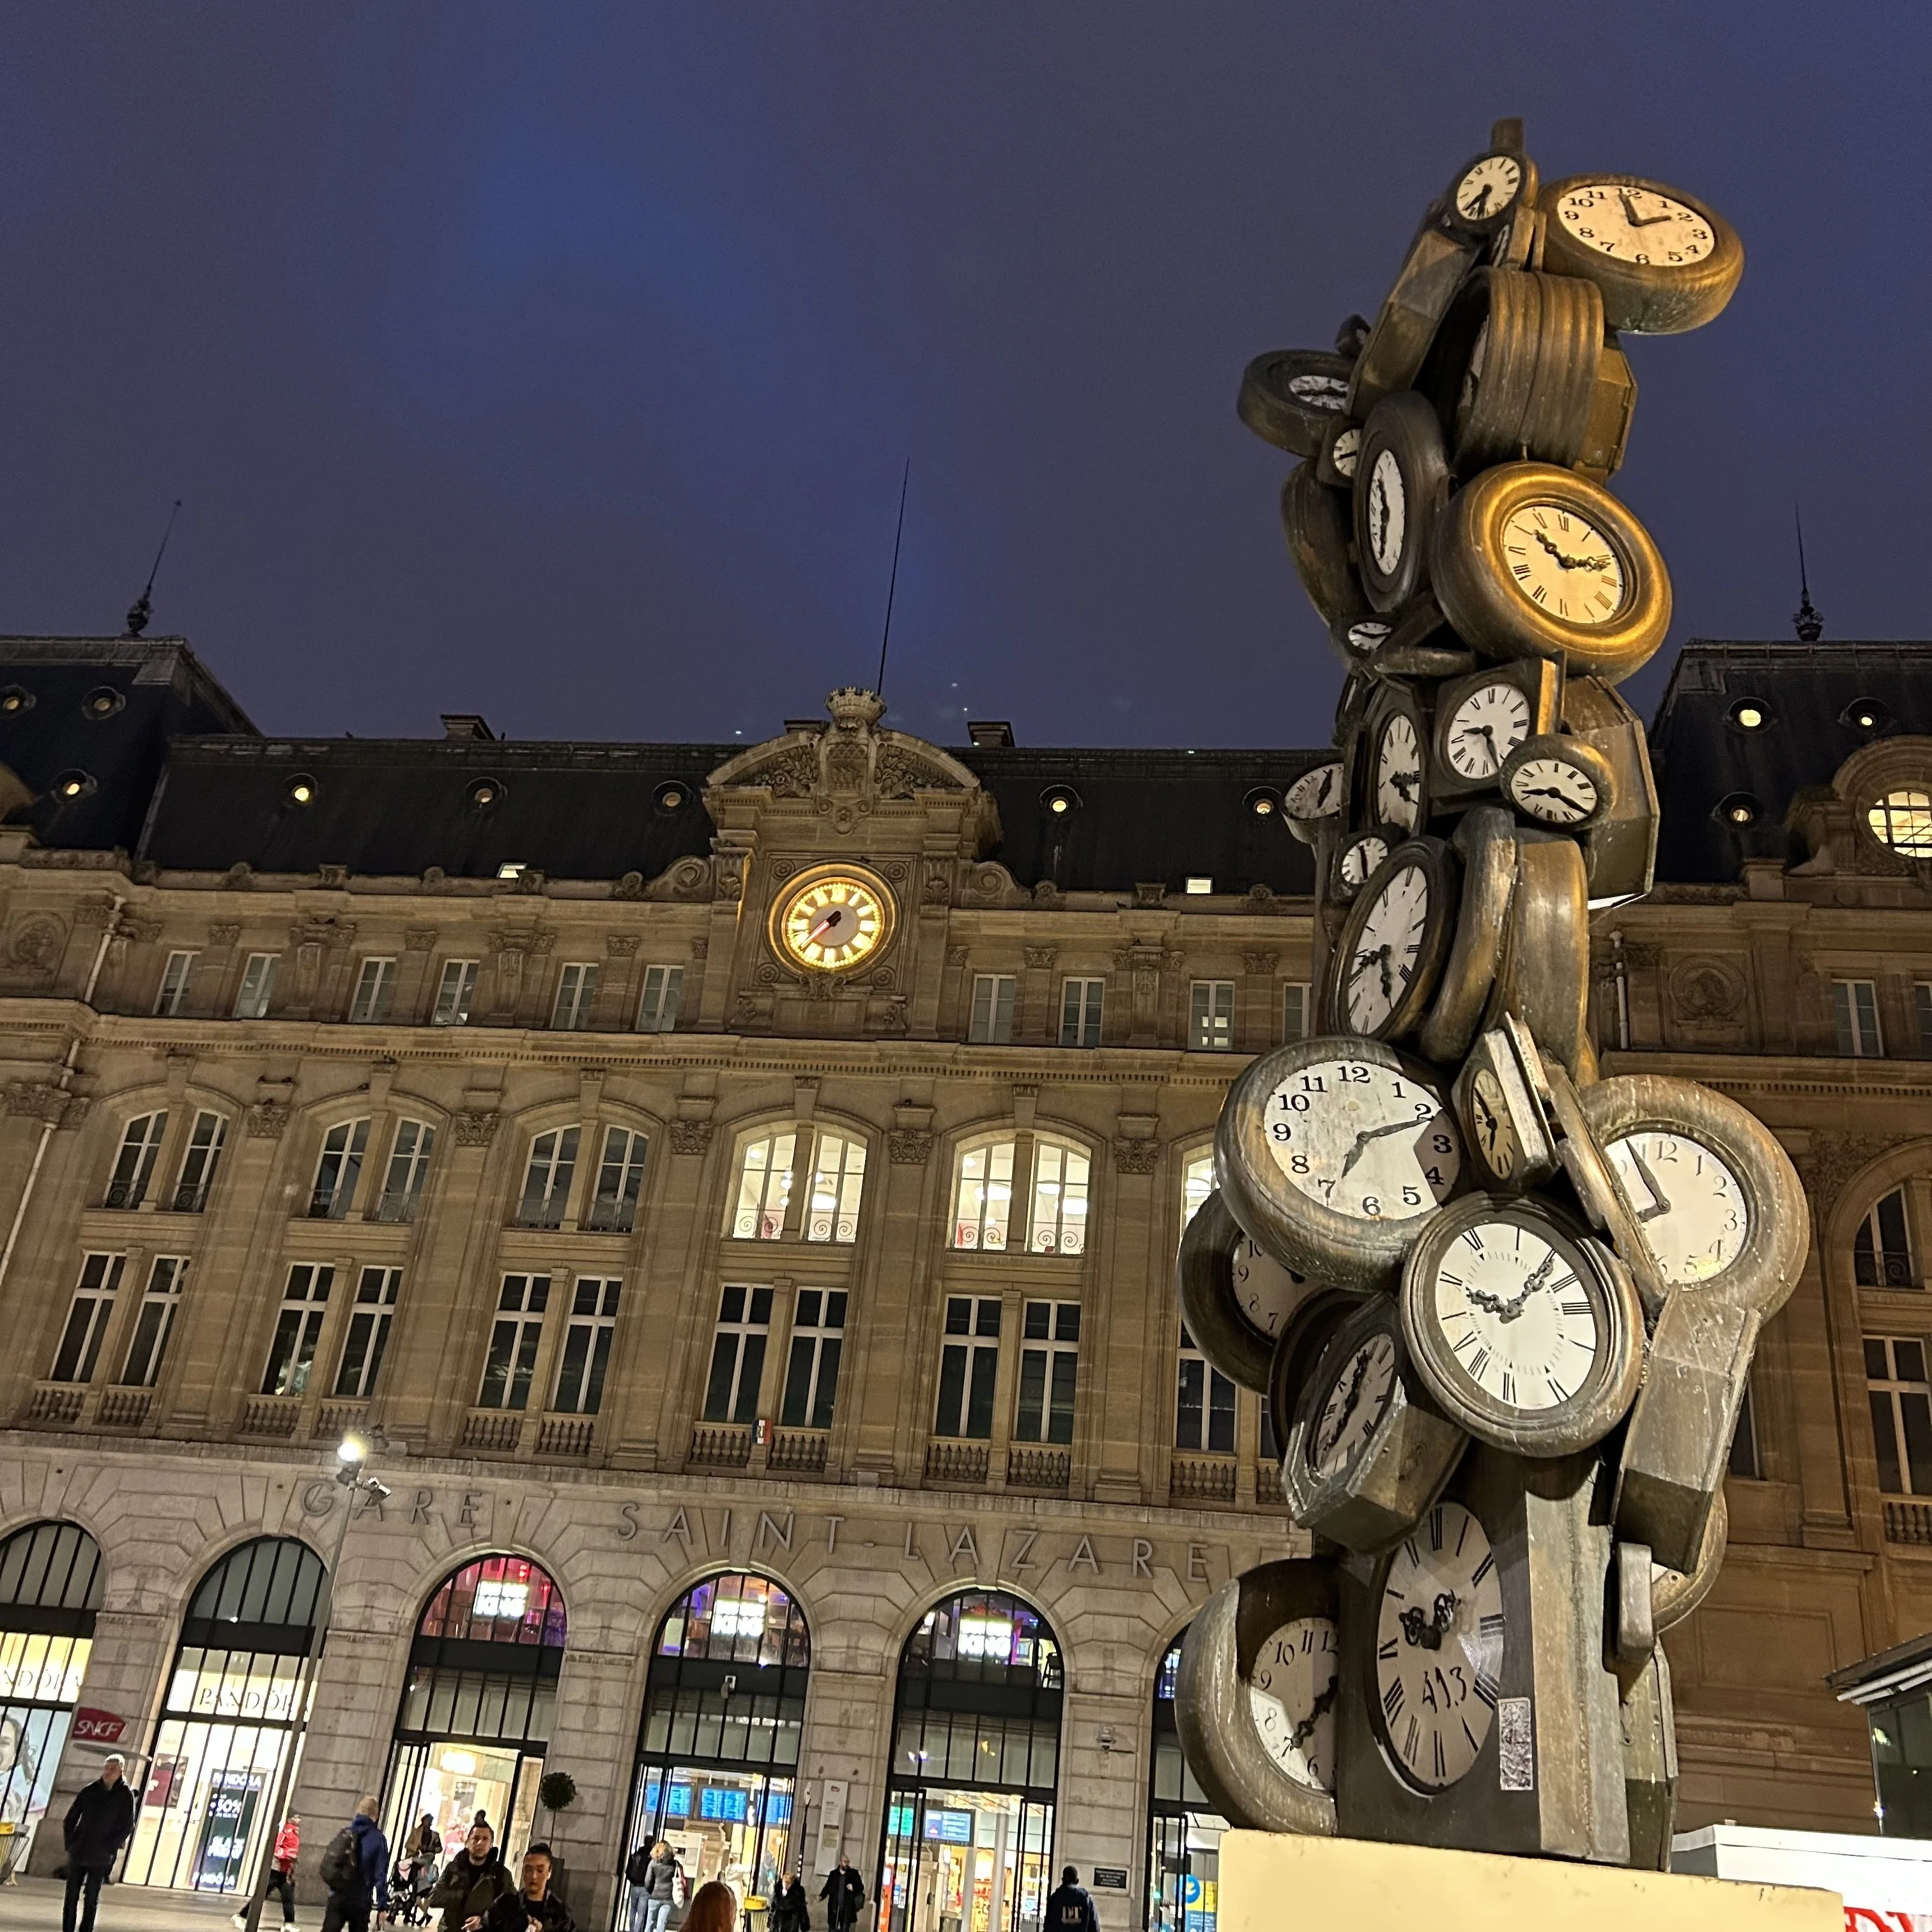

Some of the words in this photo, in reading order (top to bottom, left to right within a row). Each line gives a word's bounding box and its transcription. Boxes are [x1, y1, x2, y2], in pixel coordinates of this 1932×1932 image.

[1586, 190, 1607, 199] 11
[1615, 187, 1642, 199] 12
[1568, 197, 1594, 208] 10
[1660, 200, 1671, 210] 1
[1565, 210, 1579, 220] 9
[1677, 212, 1694, 222] 2
[1579, 227, 1595, 238] 8
[1693, 228, 1708, 240] 3
[1600, 240, 1615, 252] 7
[1685, 245, 1701, 254] 4
[1636, 254, 1650, 264] 6
[1669, 250, 1683, 262] 5
[1300, 1075, 1328, 1093] 11
[1337, 1066, 1370, 1084] 12
[1392, 1082, 1406, 1098] 1
[1278, 1094, 1310, 1112] 10
[1414, 1103, 1434, 1120] 2
[1273, 1123, 1291, 1141] 9
[1432, 1135, 1452, 1153] 3
[1656, 1140, 1678, 1163] 12
[1291, 1155, 1310, 1174] 8
[1696, 1154, 1702, 1176] 1
[1425, 1167, 1444, 1185] 4
[1318, 1179, 1336, 1199] 7
[1402, 1186, 1421, 1206] 5
[1713, 1176, 1728, 1198] 2
[1362, 1197, 1381, 1216] 6
[1724, 1209, 1738, 1230] 3
[1238, 1265, 1249, 1283] 9
[1684, 1254, 1699, 1276] 5
[1250, 1293, 1261, 1313] 8
[1269, 1312, 1278, 1330] 7
[303, 1483, 482, 1528] GARE
[1300, 1630, 1314, 1654] 11
[1275, 1641, 1295, 1666] 10
[1261, 1669, 1272, 1691] 9
[74, 1719, 119, 1737] SNCF
[1265, 1707, 1276, 1732] 8
[1307, 1754, 1319, 1777] 6
